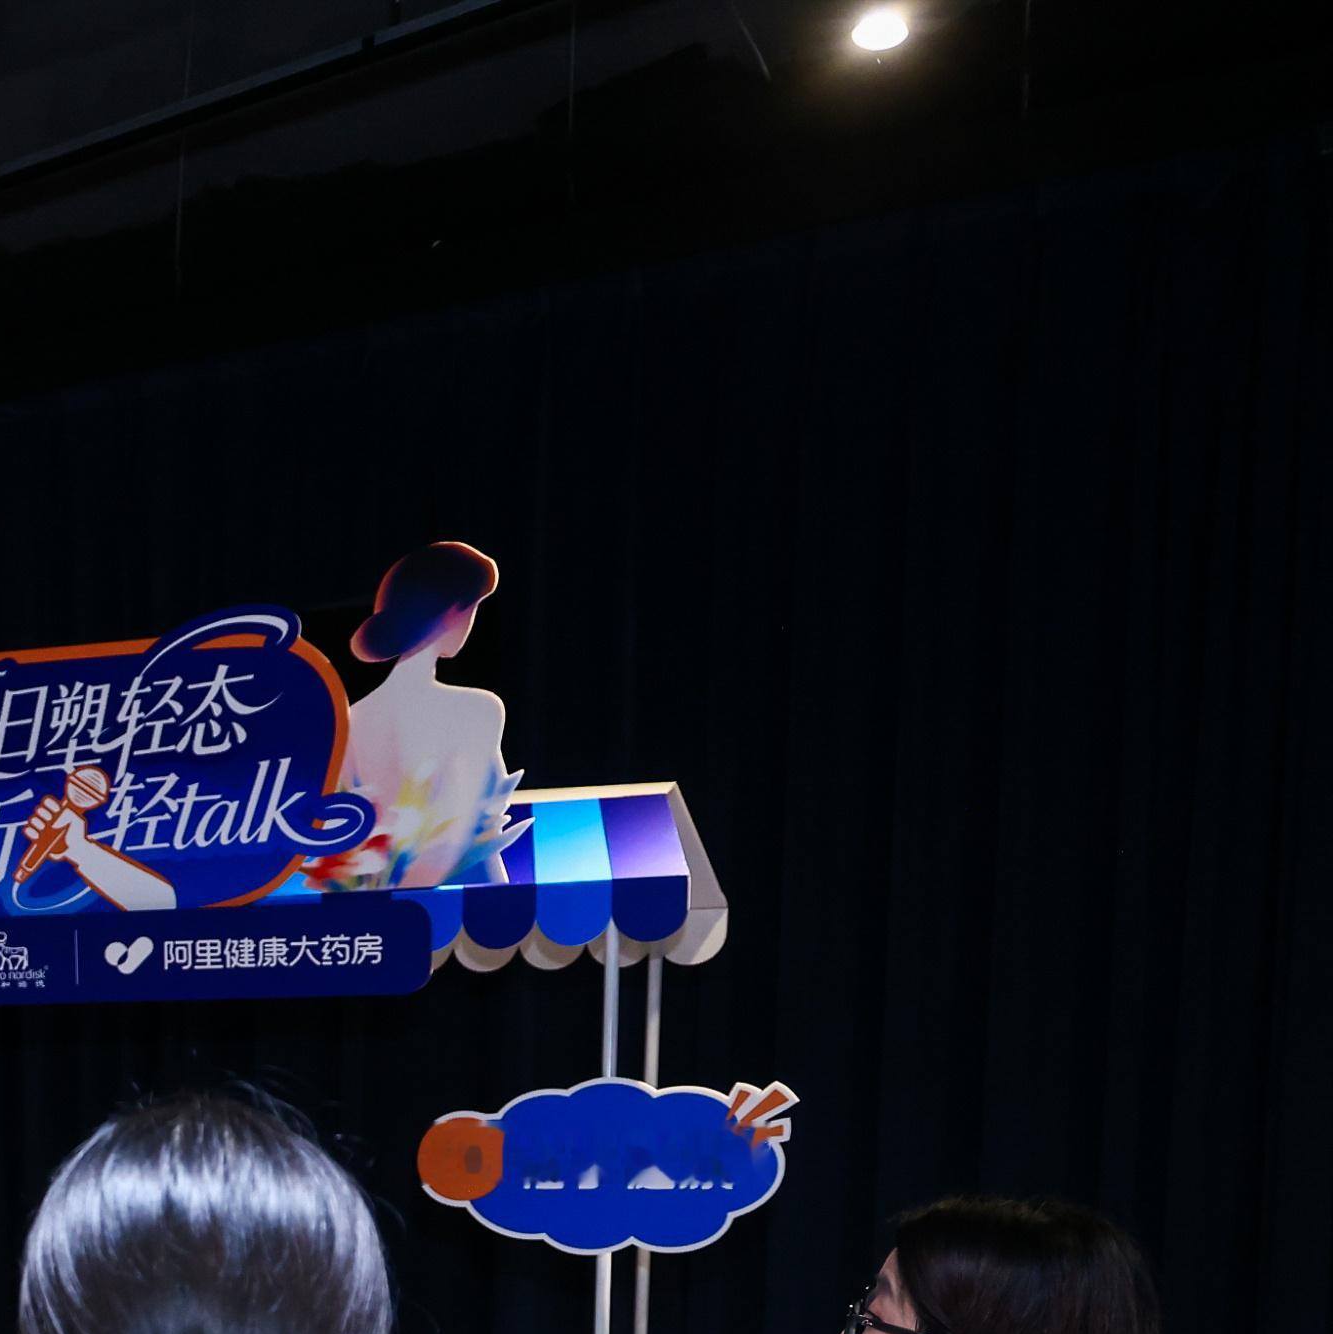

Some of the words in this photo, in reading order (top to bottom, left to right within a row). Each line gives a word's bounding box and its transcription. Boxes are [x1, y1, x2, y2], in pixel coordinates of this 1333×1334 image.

[162, 932, 384, 971] 阿里健康大药房
